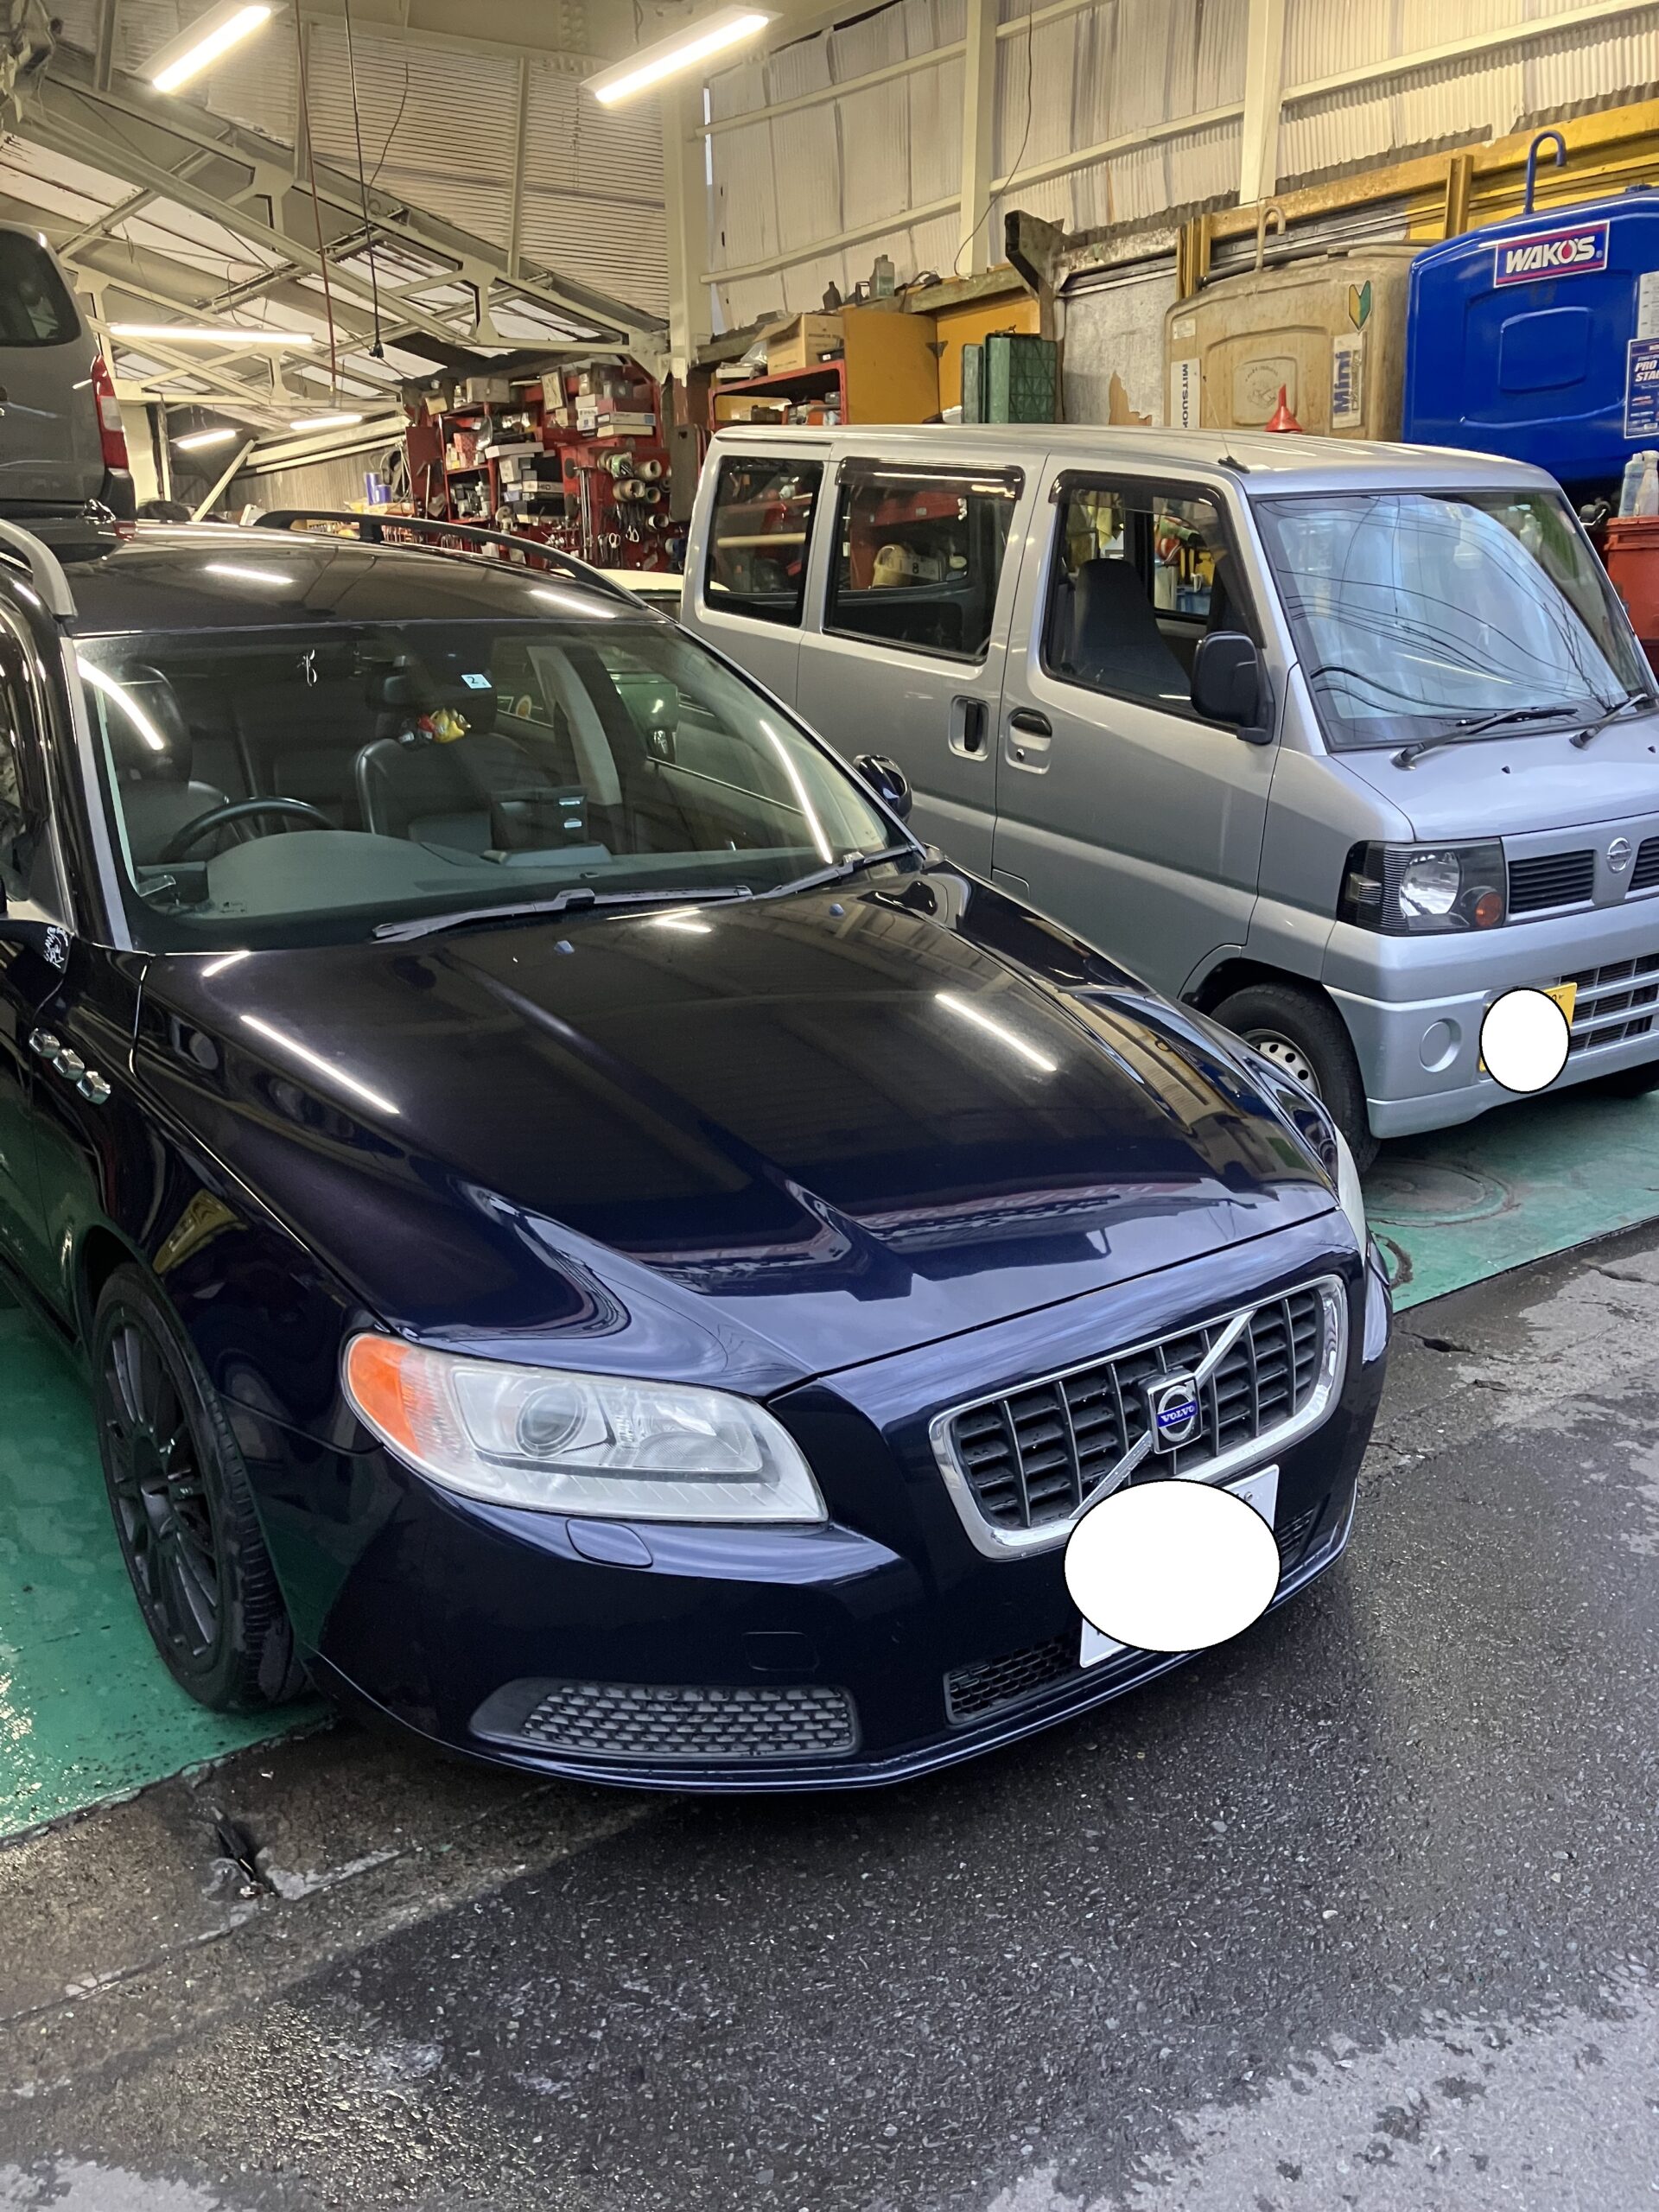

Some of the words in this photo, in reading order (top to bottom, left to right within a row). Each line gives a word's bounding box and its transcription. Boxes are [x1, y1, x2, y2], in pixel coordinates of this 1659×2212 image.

[1506, 236, 1595, 274] WAKO'S
[1634, 359, 1658, 372] PRO
[1160, 1405, 1195, 1422] VOLVO
